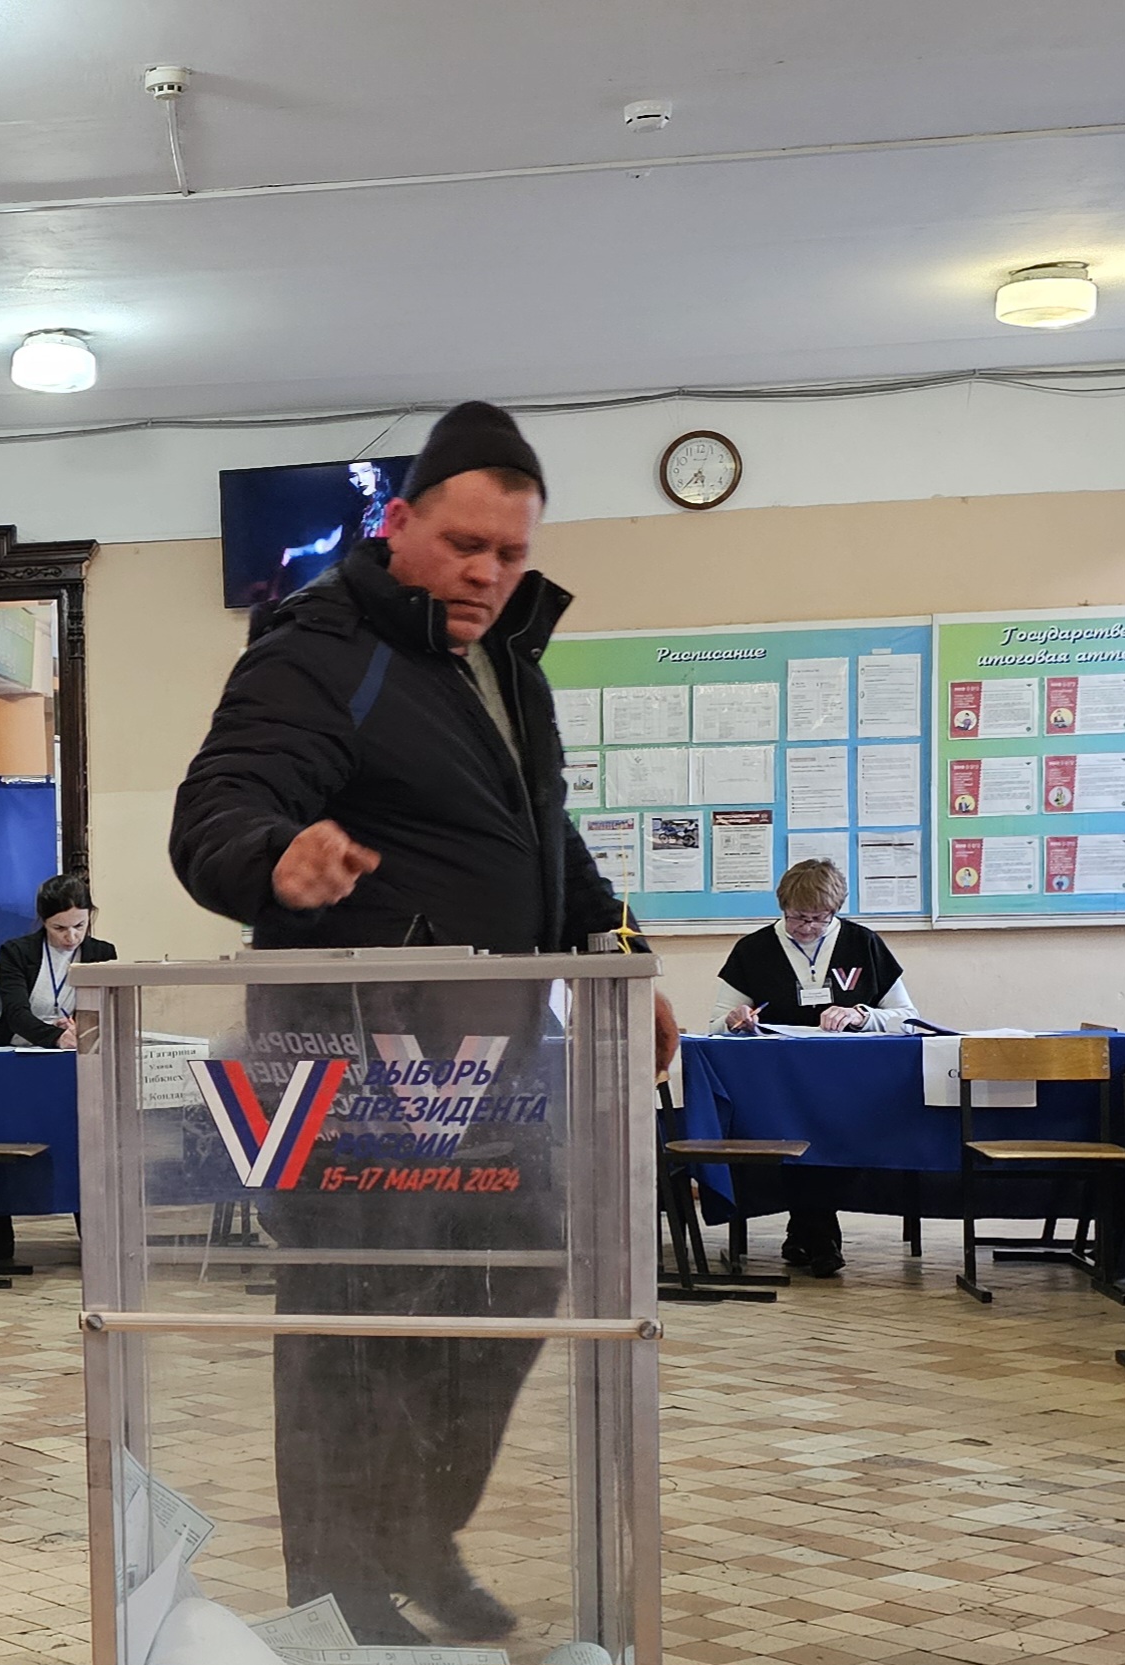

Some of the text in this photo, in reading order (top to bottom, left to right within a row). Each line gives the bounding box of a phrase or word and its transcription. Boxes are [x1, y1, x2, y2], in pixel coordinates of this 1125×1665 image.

[656, 647, 767, 663] Расписание
[978, 649, 1125, 667] итоговая атт
[363, 1060, 504, 1086] ВЫБОРЫ
[346, 1096, 548, 1126] ПРЕЗИДЕНТА
[334, 1132, 462, 1159] РОССИИ
[384, 1167, 460, 1191] МАРТА
[464, 1167, 520, 1192] 2024
